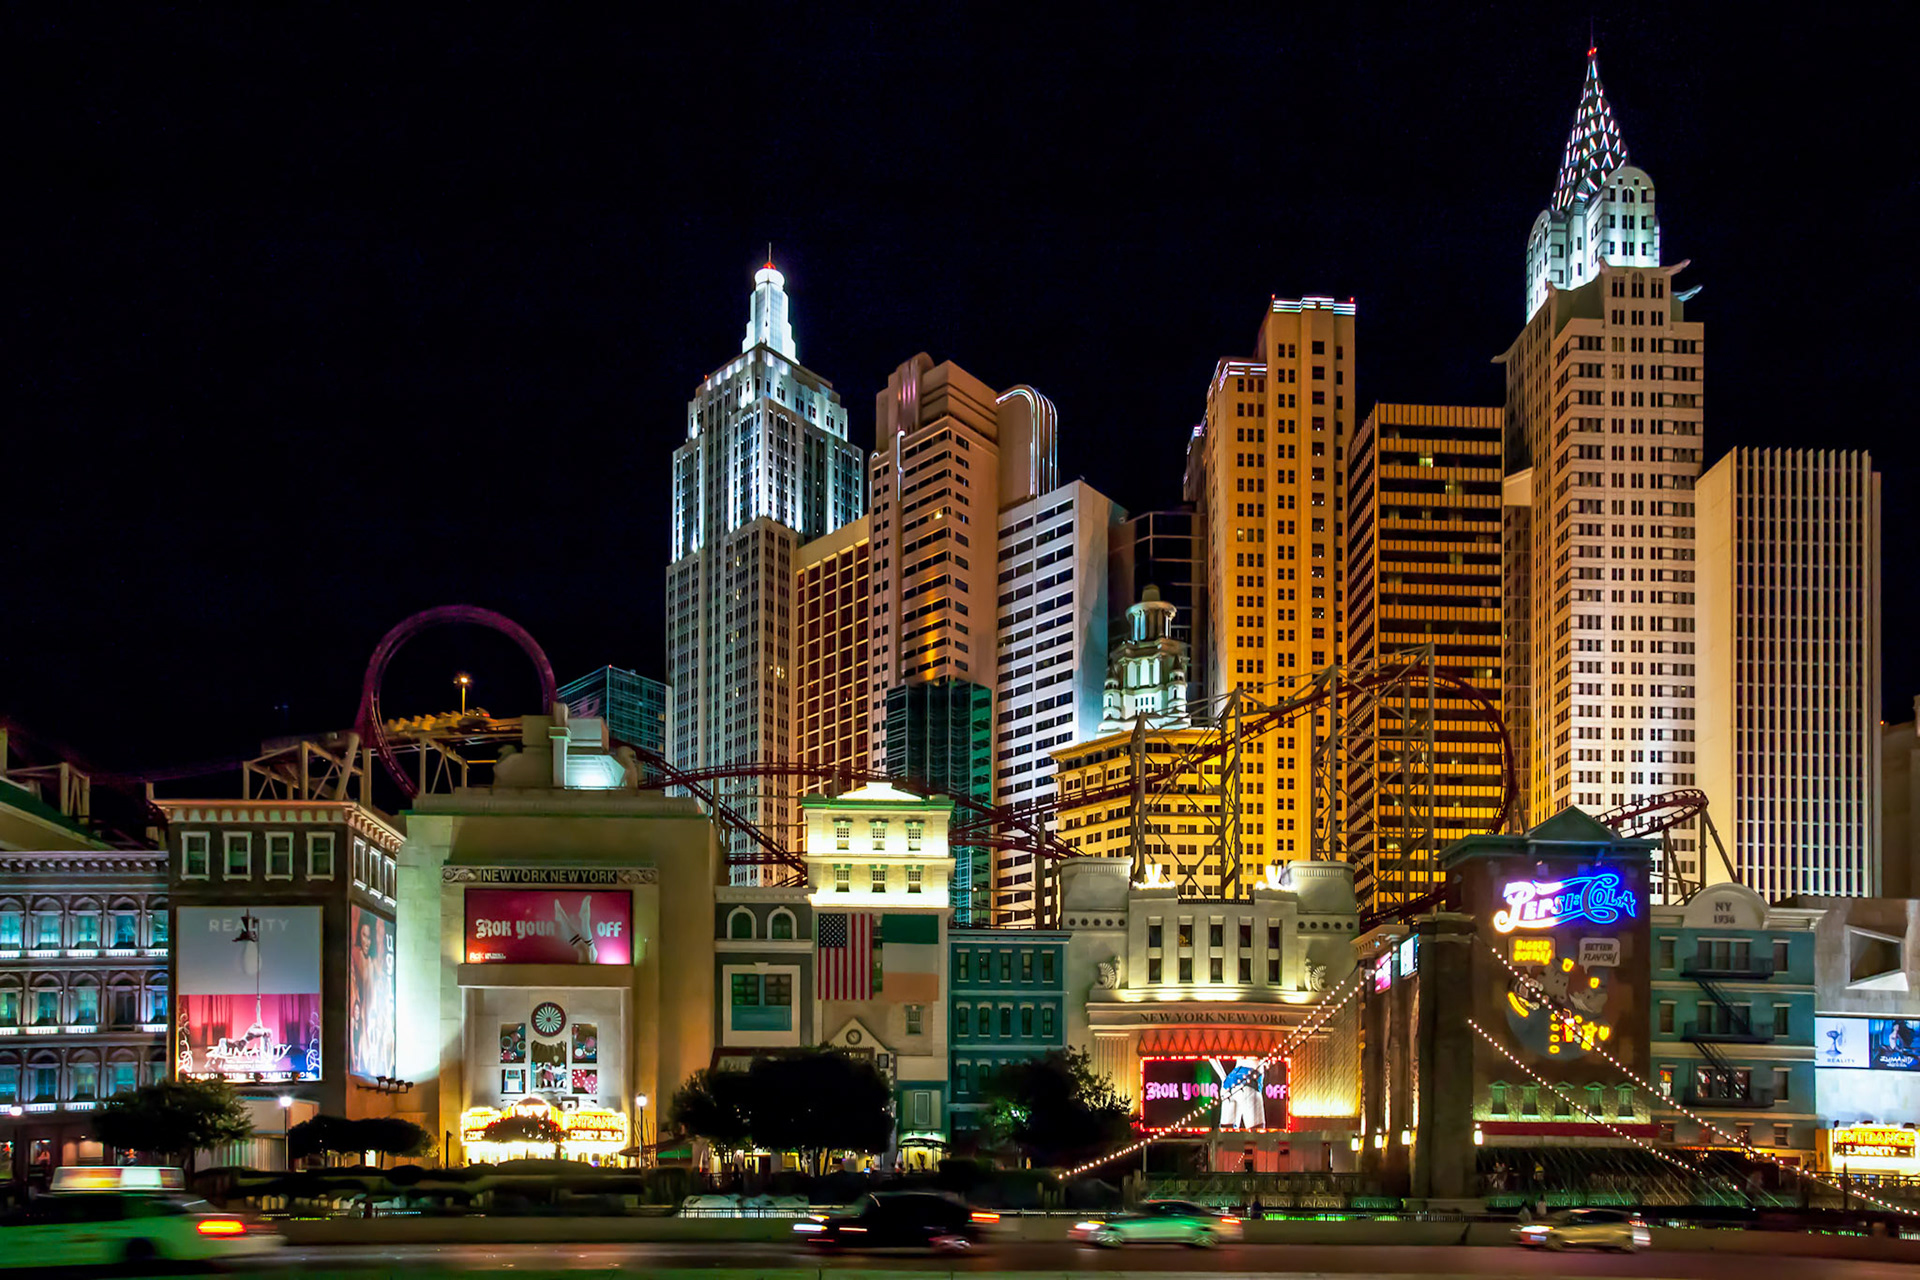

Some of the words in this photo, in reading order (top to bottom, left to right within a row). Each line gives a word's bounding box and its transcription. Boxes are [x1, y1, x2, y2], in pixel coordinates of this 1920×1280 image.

[482, 869, 512, 882] NEW
[513, 869, 548, 882] YORK
[549, 869, 580, 882] NEW
[581, 870, 616, 883] YORK
[1715, 902, 1732, 911] NY
[1585, 943, 1613, 951] BETTER
[1140, 1013, 1172, 1023] NEW
[1174, 1013, 1214, 1023] YORK
[1217, 1013, 1249, 1023] NEW
[1251, 1013, 1288, 1025] YORK
